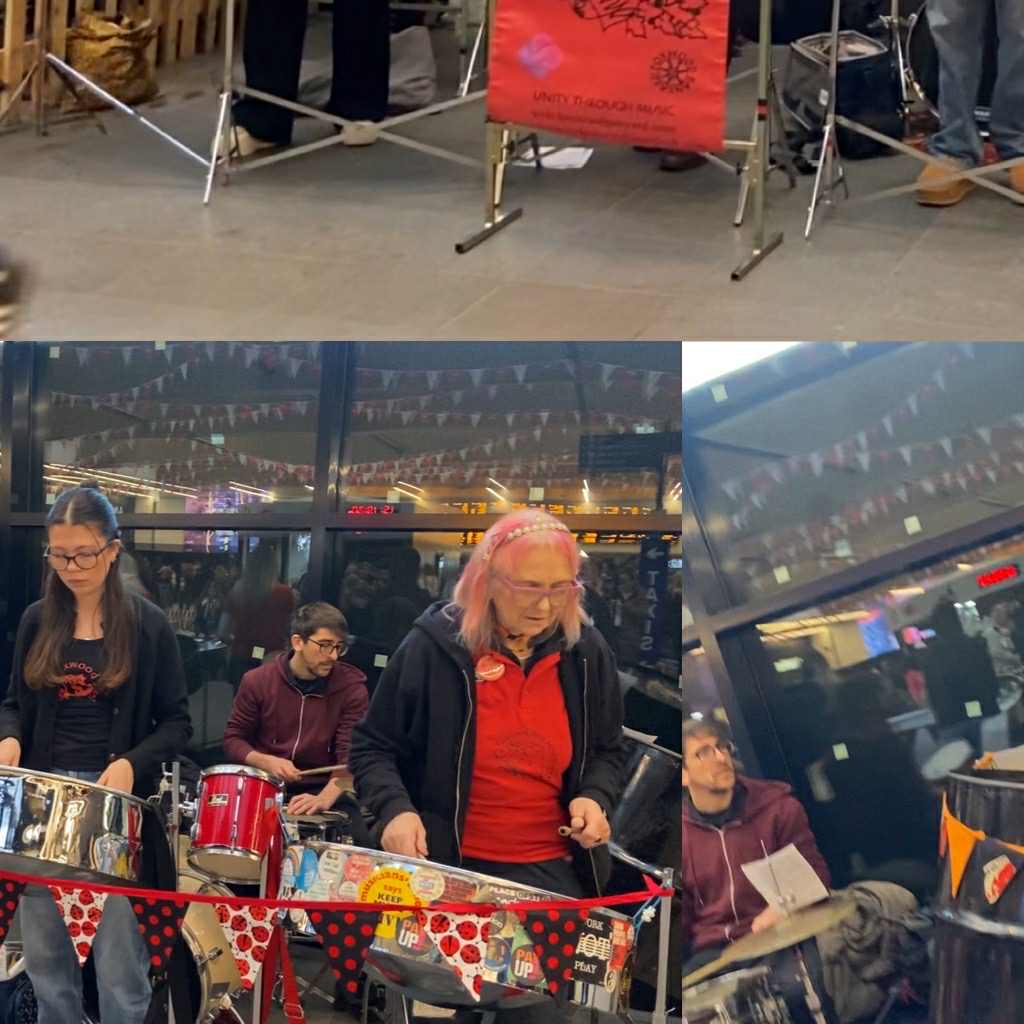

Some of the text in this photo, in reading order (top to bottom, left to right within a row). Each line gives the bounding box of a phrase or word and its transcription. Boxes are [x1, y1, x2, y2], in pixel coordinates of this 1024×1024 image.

[377, 892, 403, 903] KEEP
[583, 918, 604, 931] ORK
[399, 928, 419, 948] UP
[514, 959, 534, 978] UP
[574, 960, 598, 974] PLAY
